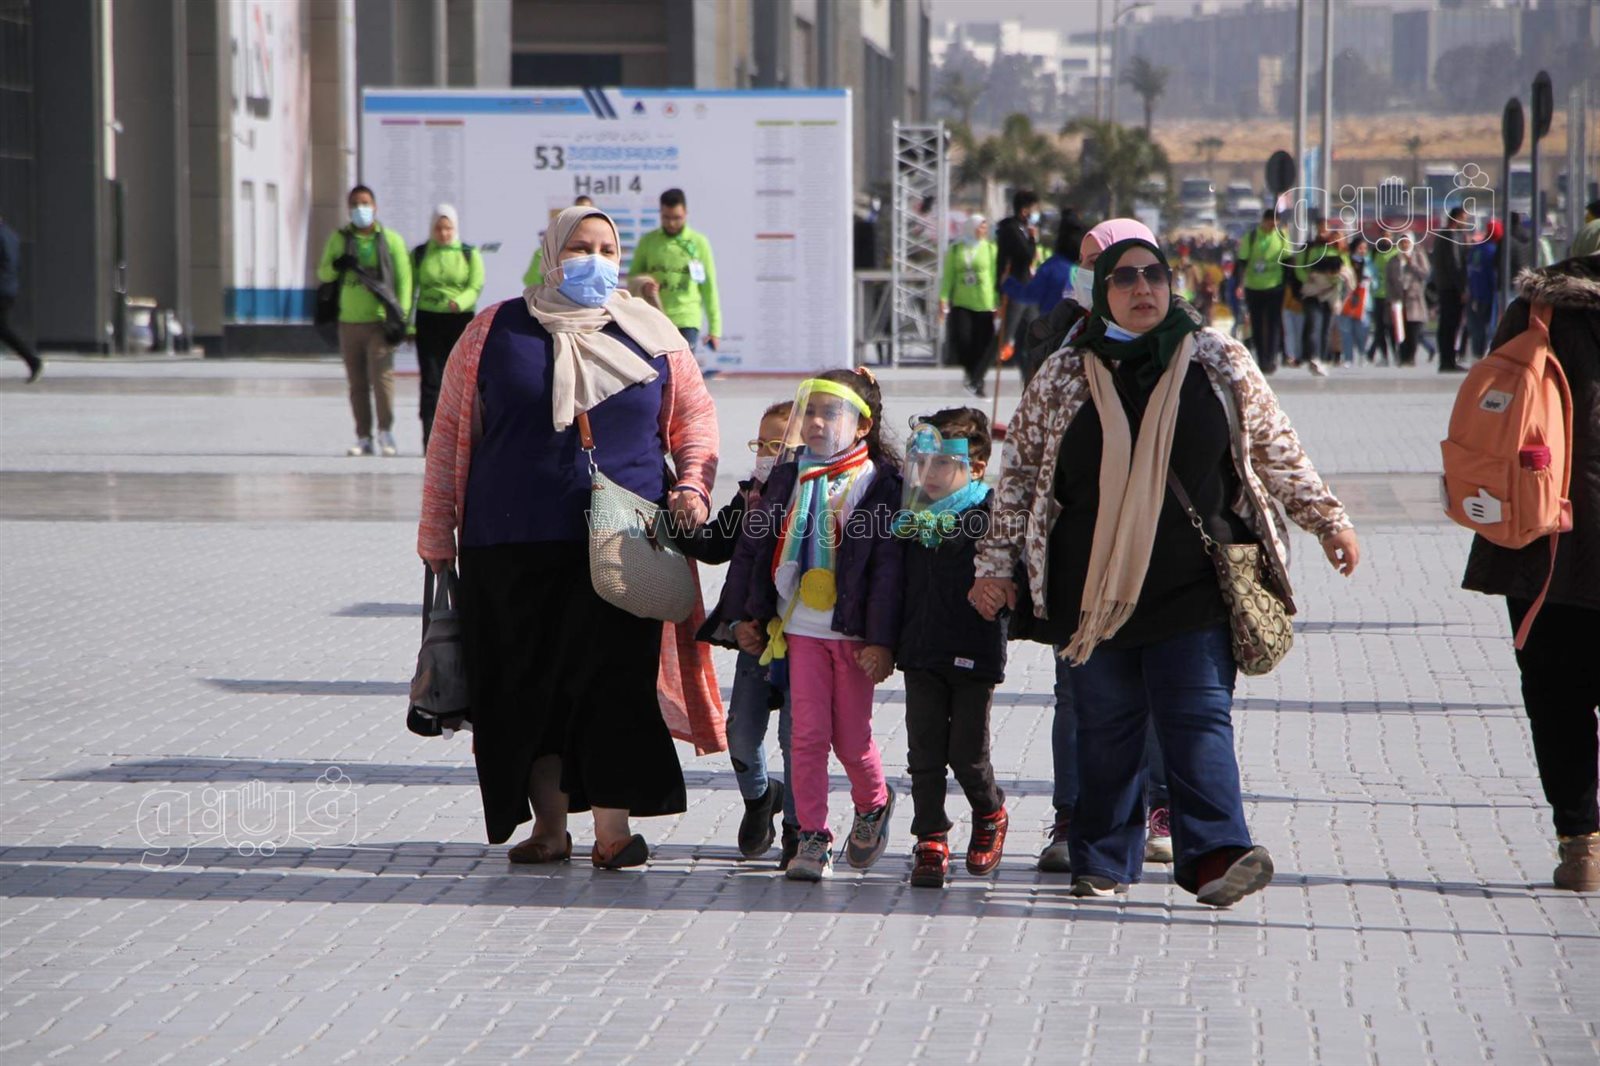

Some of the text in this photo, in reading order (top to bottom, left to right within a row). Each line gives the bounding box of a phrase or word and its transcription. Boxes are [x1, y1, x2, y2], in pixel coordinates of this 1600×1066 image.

[534, 145, 565, 170] 53
[574, 175, 642, 194] Hall 4
